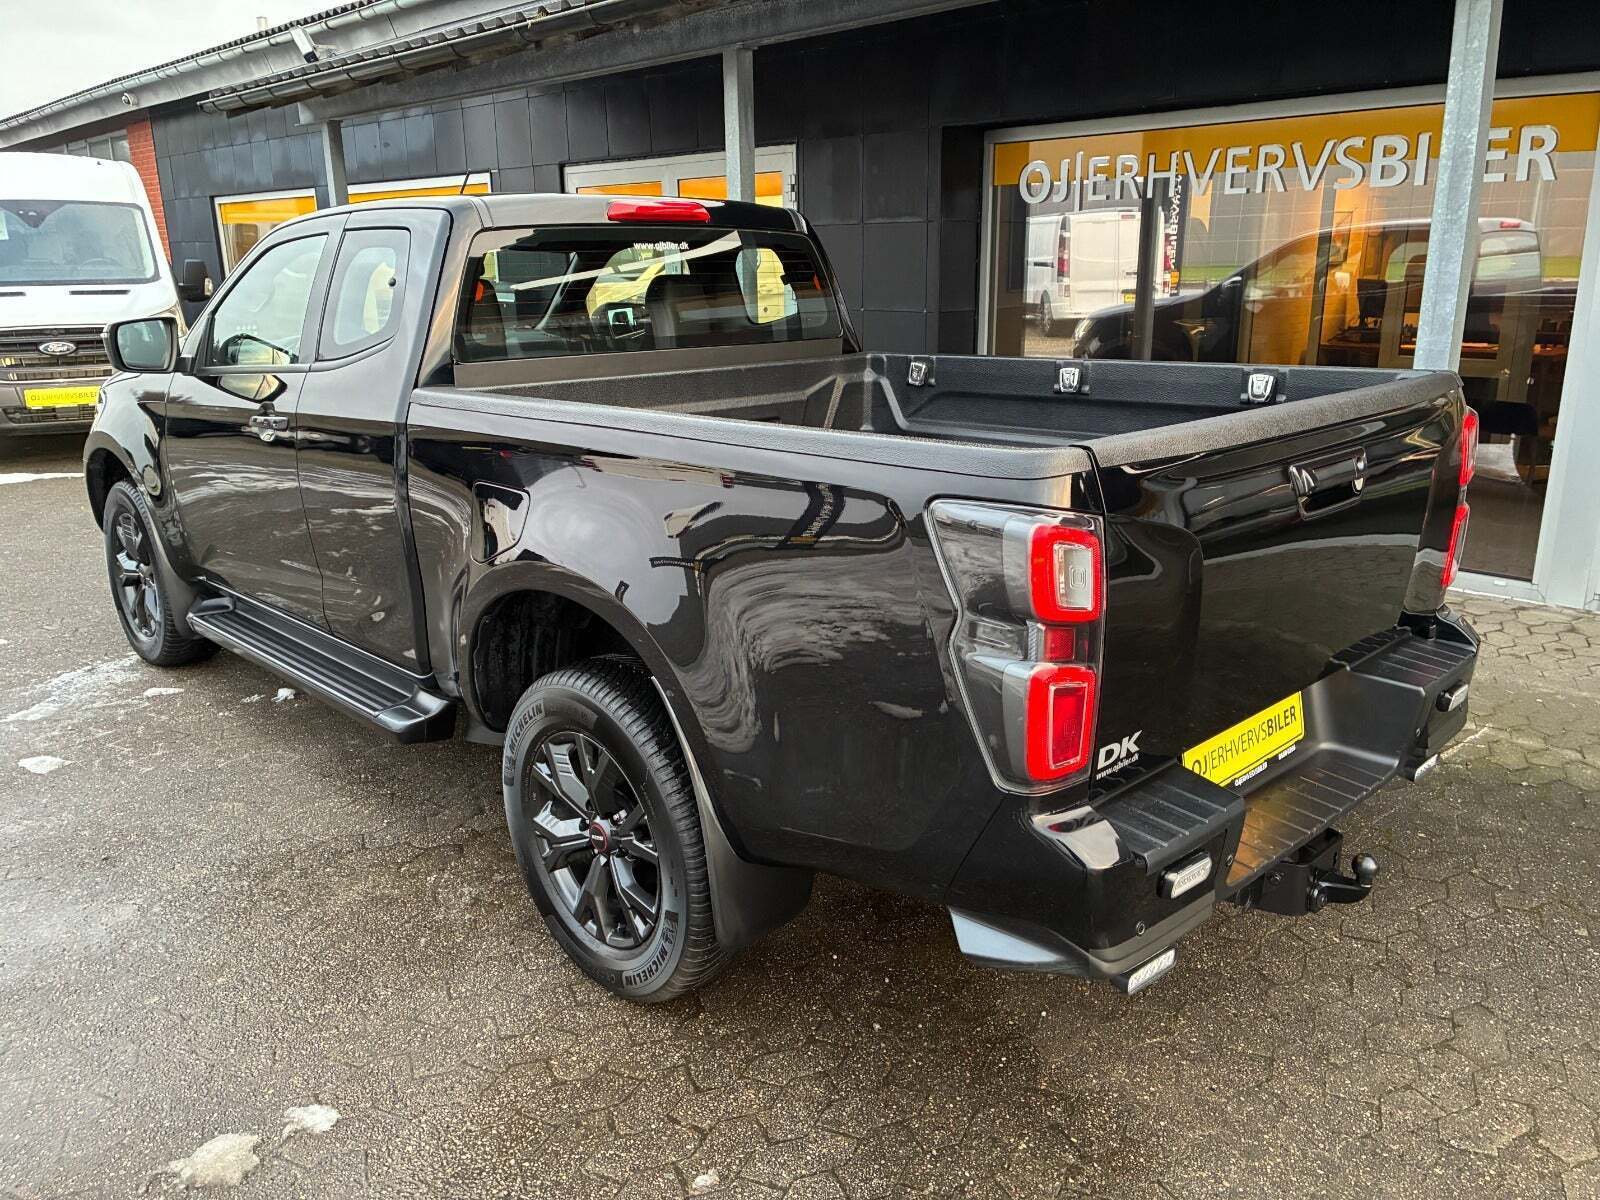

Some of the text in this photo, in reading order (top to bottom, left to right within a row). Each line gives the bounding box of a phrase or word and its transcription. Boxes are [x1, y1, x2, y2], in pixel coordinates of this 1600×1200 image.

[1019, 125, 1557, 212] OJ|ERHVERVSBIER
[509, 702, 543, 754] MICHELIN
[1097, 730, 1142, 770] DK
[625, 942, 669, 986] MICHELIN
